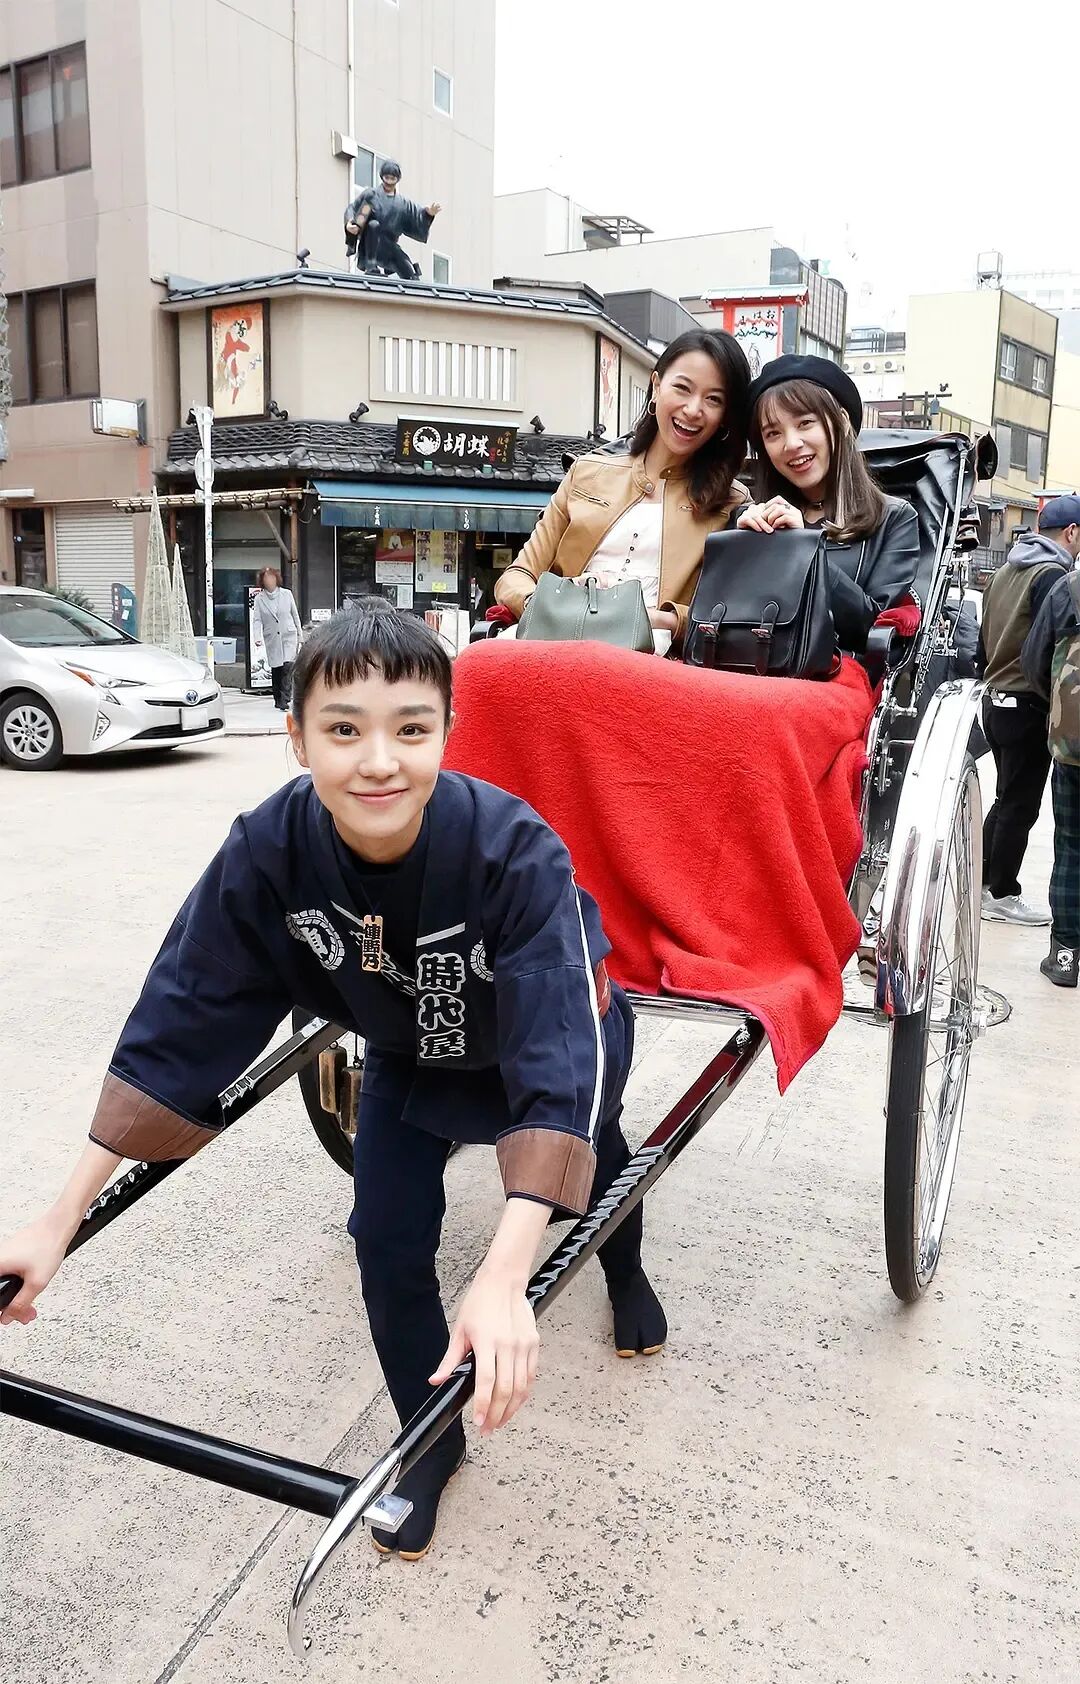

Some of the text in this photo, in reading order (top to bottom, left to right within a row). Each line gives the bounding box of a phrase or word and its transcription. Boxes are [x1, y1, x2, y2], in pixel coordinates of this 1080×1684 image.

[443, 433, 490, 457] 胡蝶
[416, 952, 467, 1059] 時代屋
